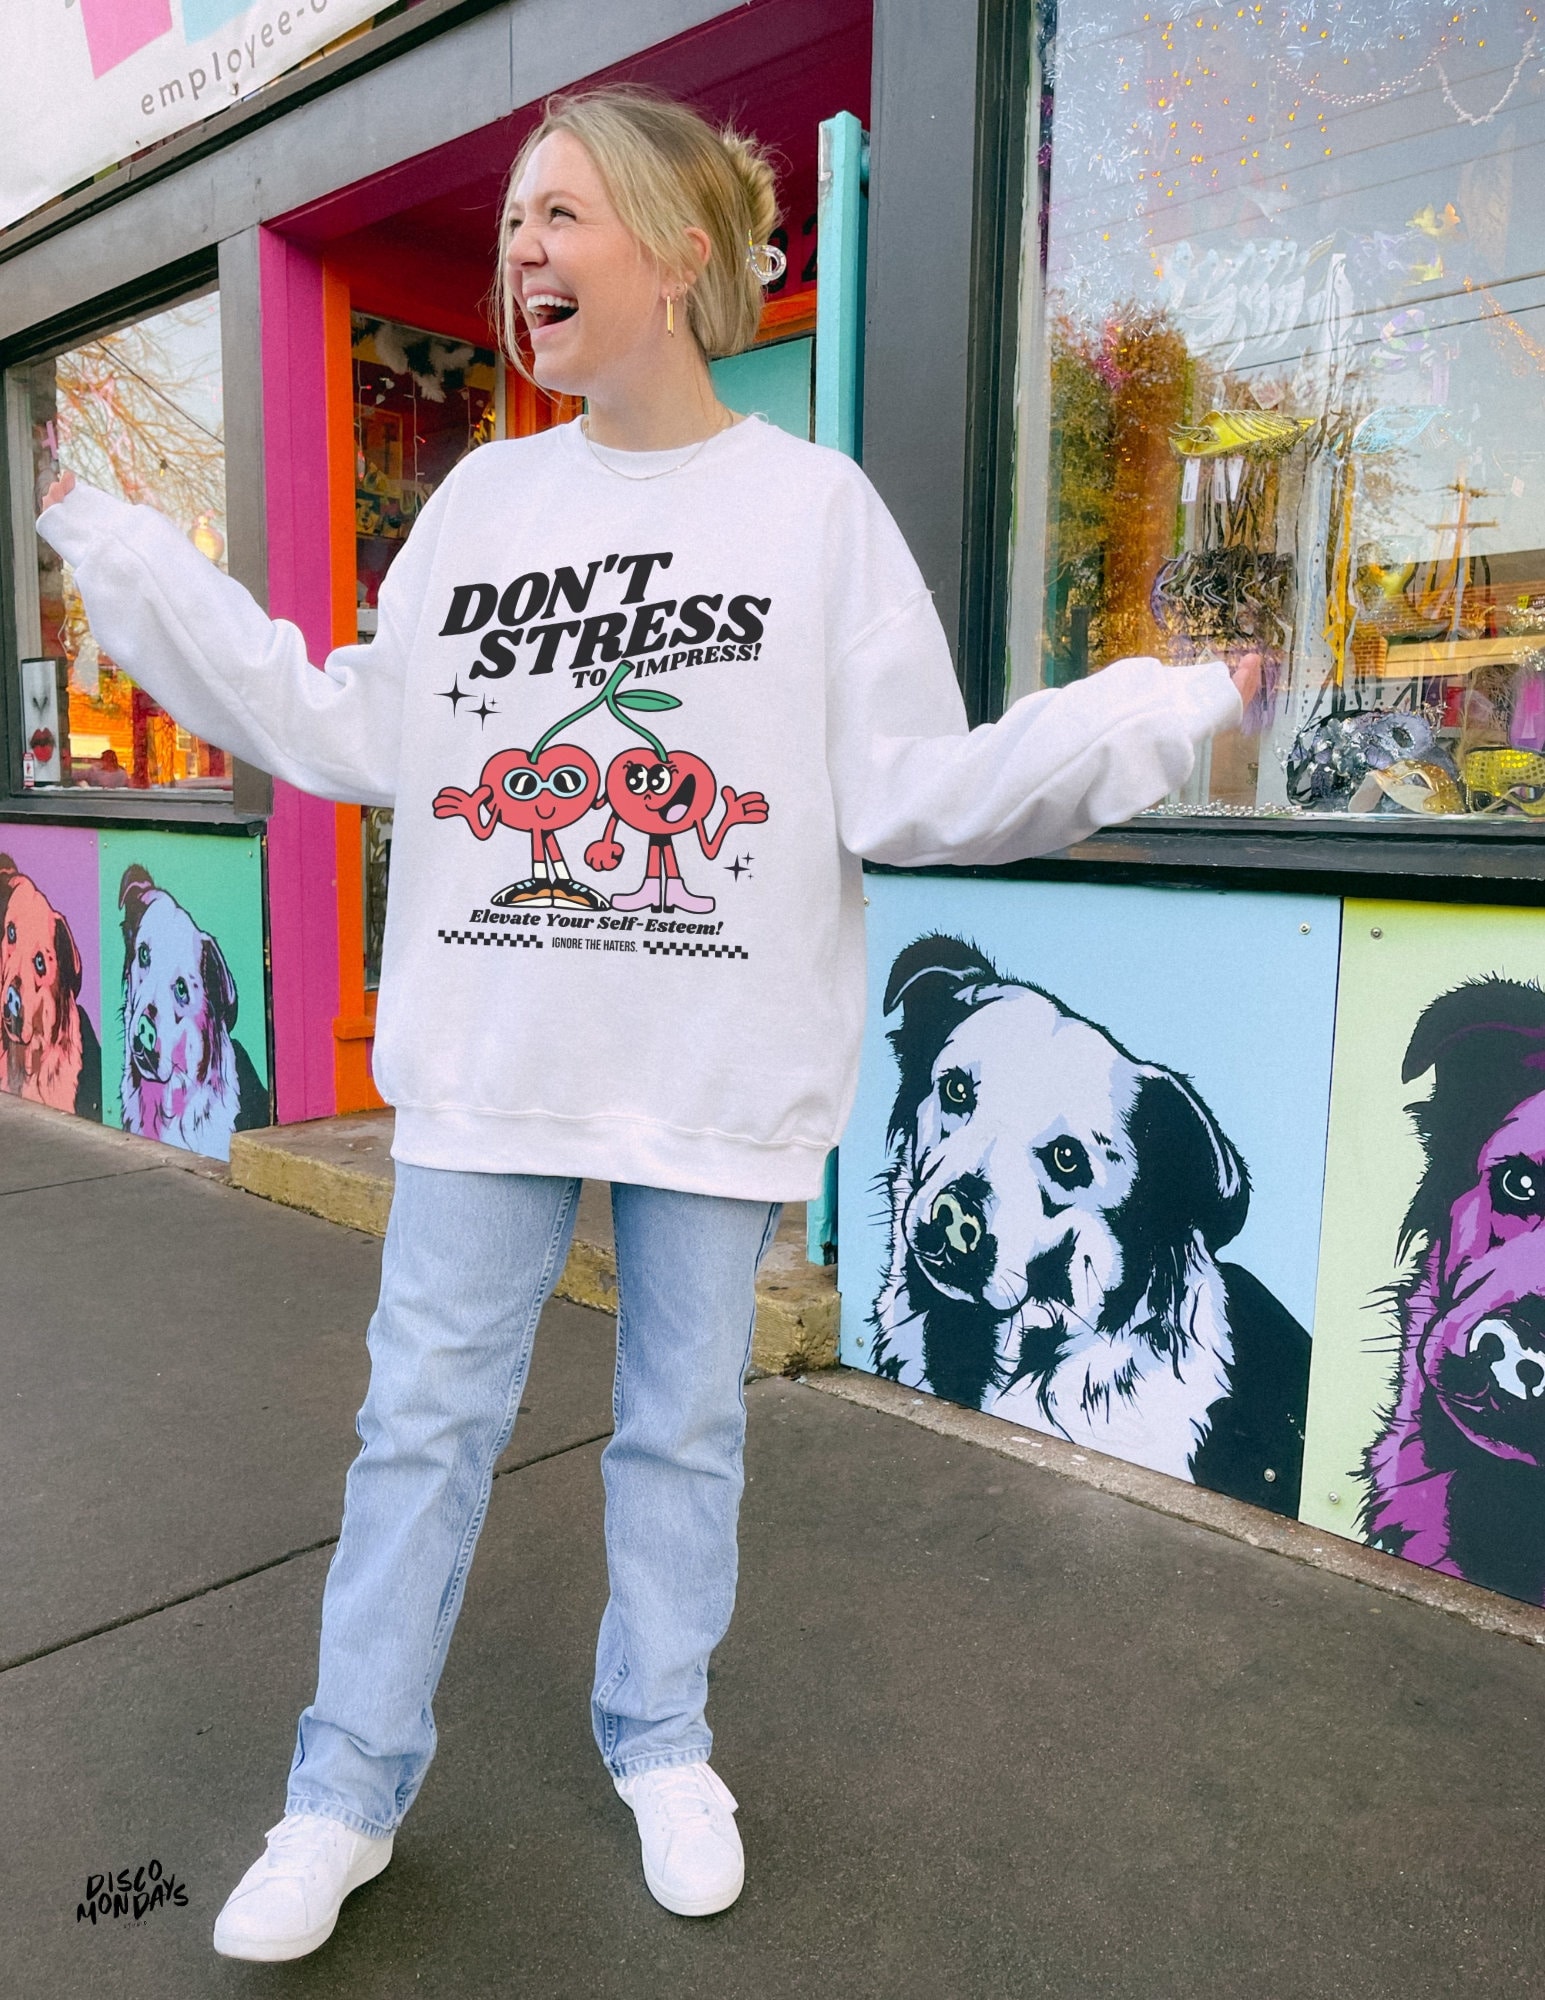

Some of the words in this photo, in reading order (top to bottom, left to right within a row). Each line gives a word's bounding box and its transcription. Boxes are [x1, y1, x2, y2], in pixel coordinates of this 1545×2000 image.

[438, 551, 674, 637] DON'T
[468, 593, 772, 680] STRESS
[572, 668, 607, 689] TO
[634, 642, 762, 679] IMPRESS!
[469, 908, 542, 926] Elevate
[546, 913, 595, 929] Your
[596, 916, 724, 936] Self-Esteem!
[551, 936, 584, 950] IGNORE
[584, 938, 602, 951] THE
[603, 939, 638, 953] HATERS.
